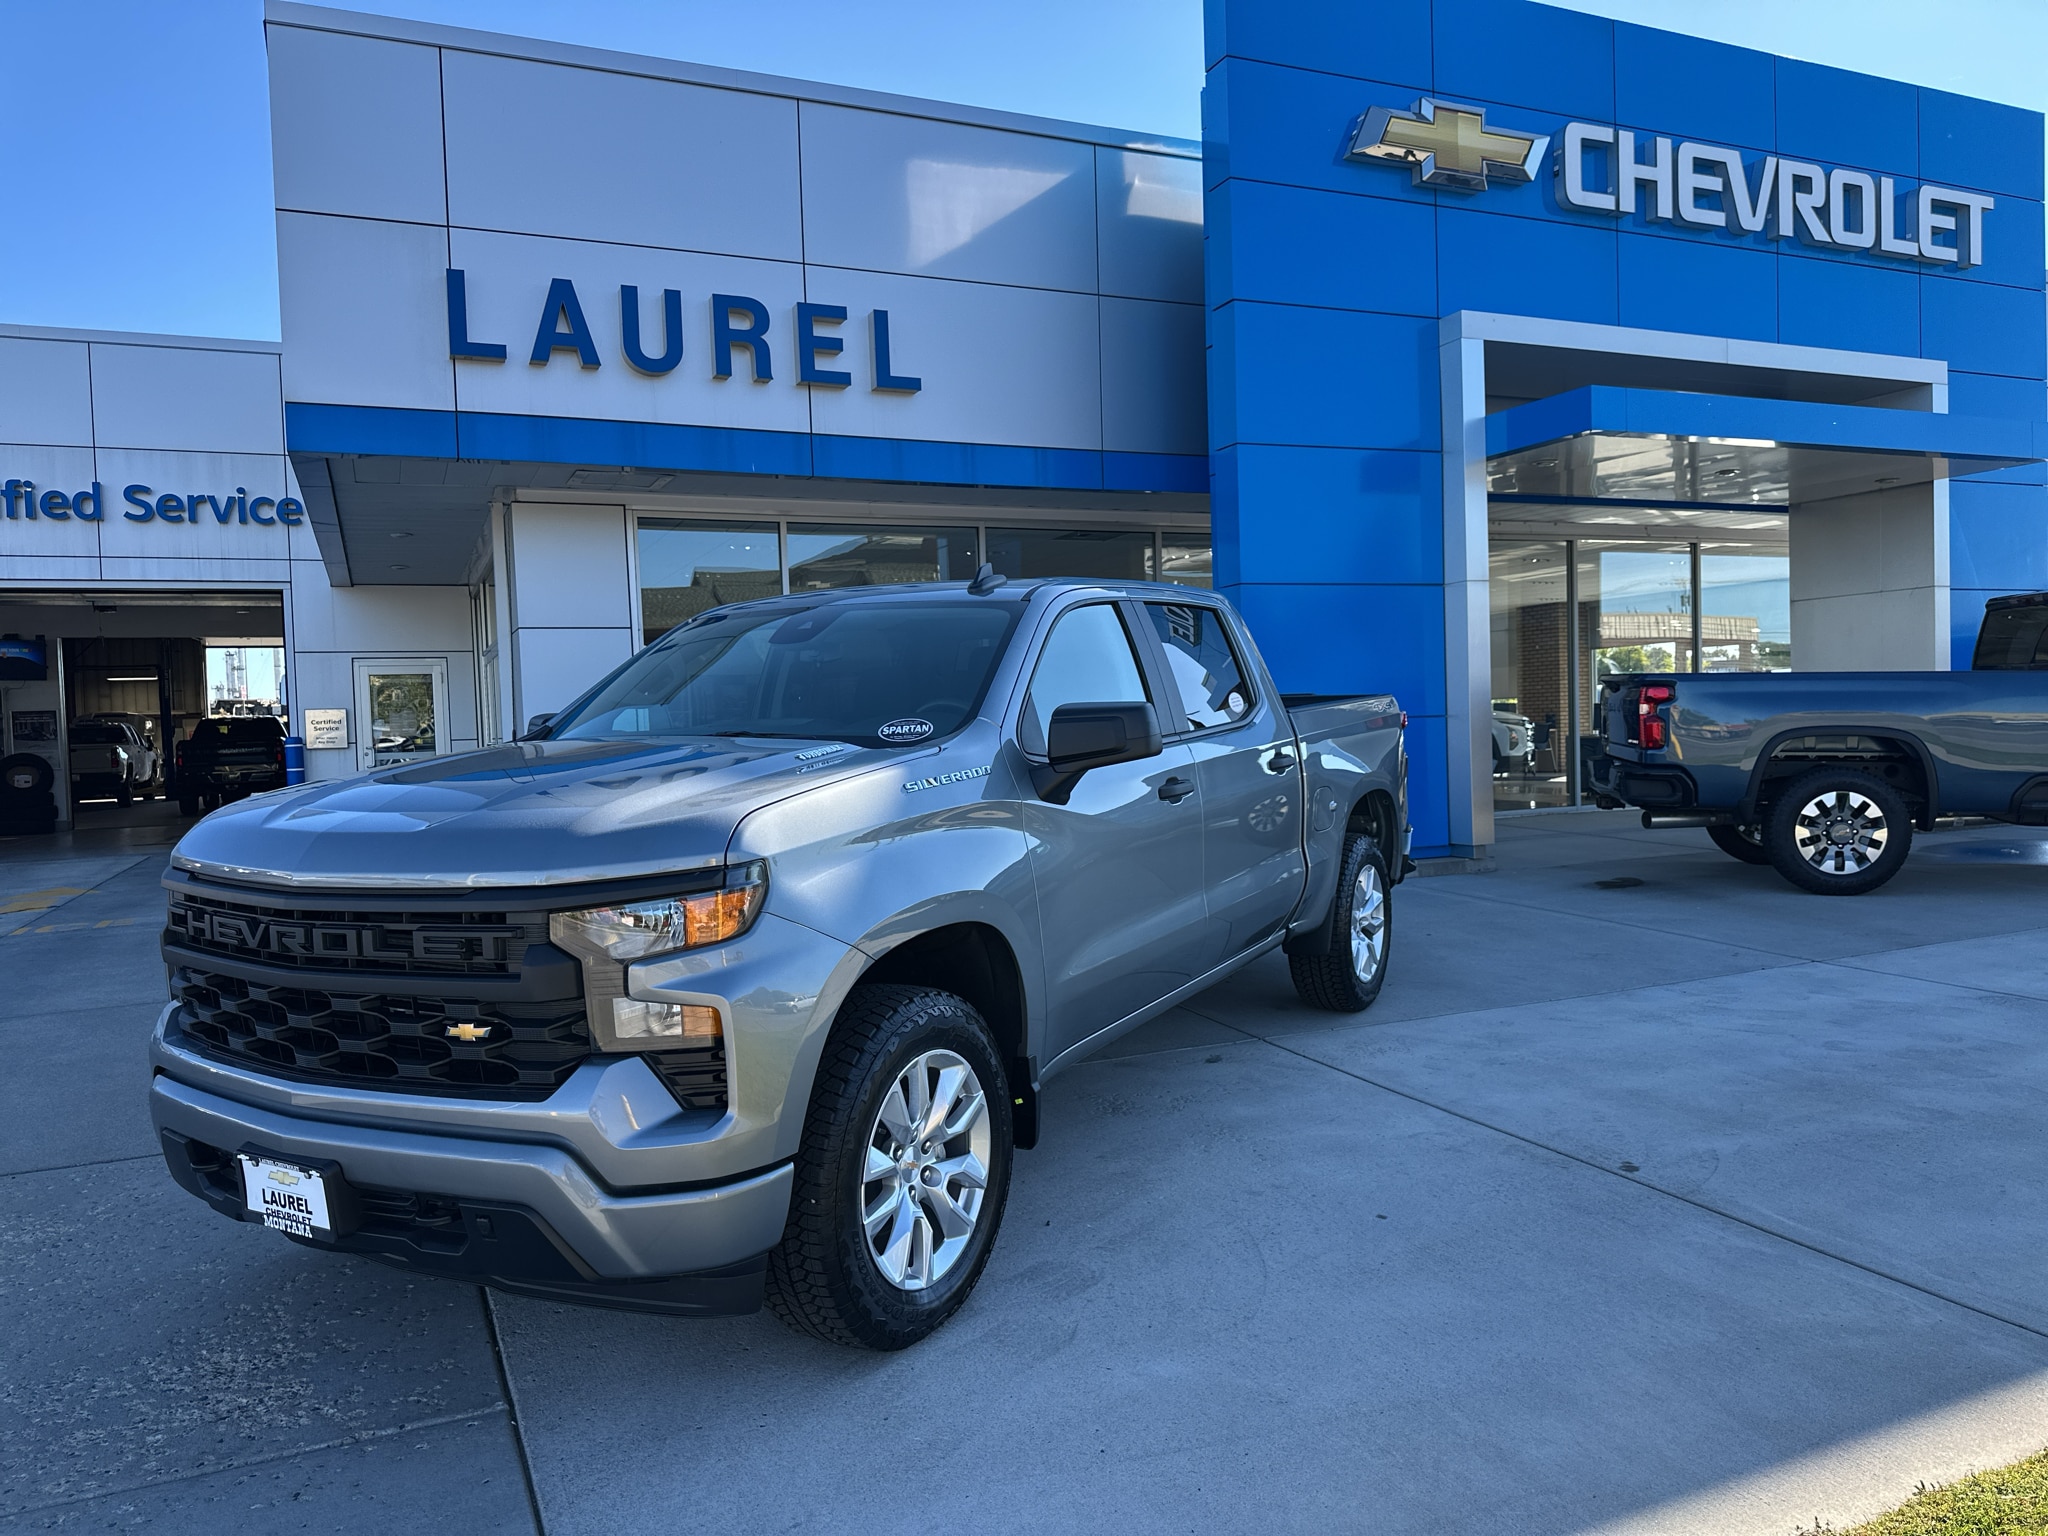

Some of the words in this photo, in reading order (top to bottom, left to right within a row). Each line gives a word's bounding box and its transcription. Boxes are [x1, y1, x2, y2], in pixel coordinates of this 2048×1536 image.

[1556, 121, 1994, 269] CHEVROLET
[446, 268, 922, 394] LAUREL
[123, 484, 304, 526] Service
[882, 724, 929, 735] SPARTAN
[903, 765, 992, 793] SILVERADO
[167, 905, 529, 962] CHEVROLET
[262, 1188, 313, 1215] LAUREL
[263, 1214, 313, 1238] MONTANA
[265, 1207, 312, 1226] CHEVROLET
